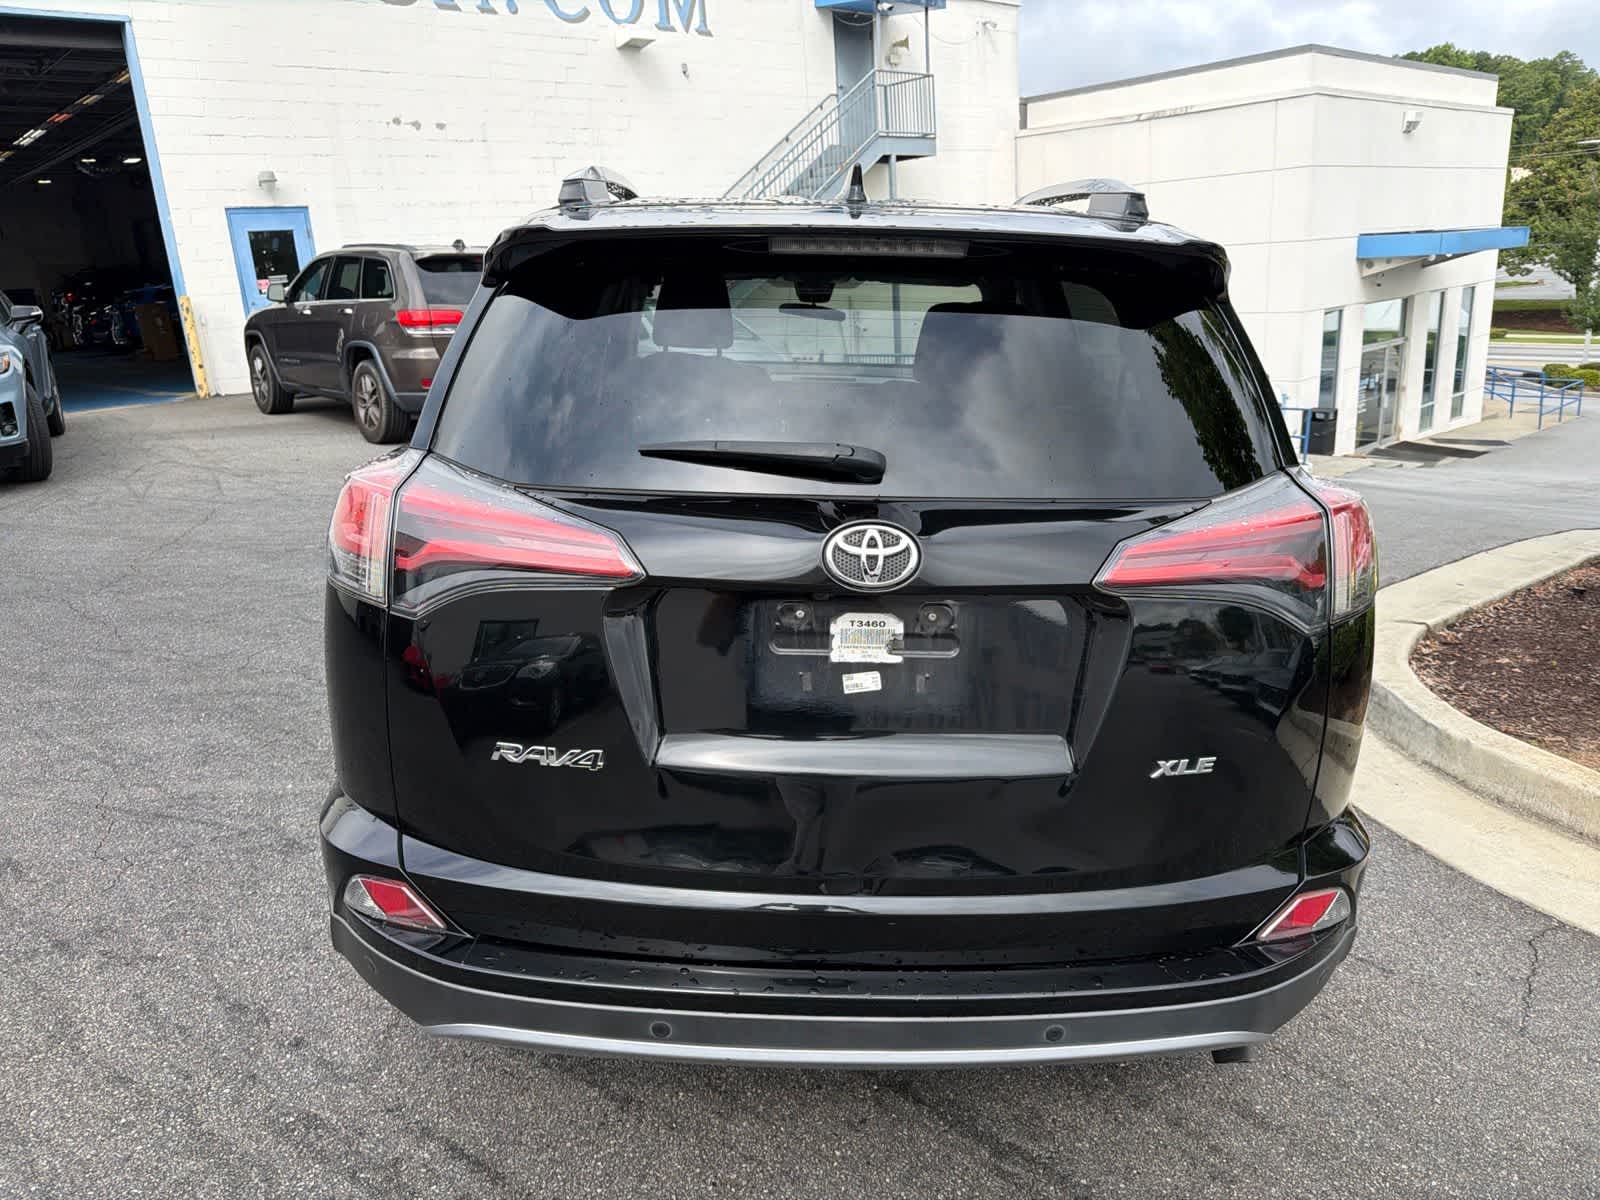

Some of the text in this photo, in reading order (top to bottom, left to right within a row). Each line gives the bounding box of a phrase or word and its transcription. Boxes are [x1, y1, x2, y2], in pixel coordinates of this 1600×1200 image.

[849, 620, 886, 628] T3460
[490, 741, 604, 771] RAV4
[1150, 756, 1217, 778] XLE
